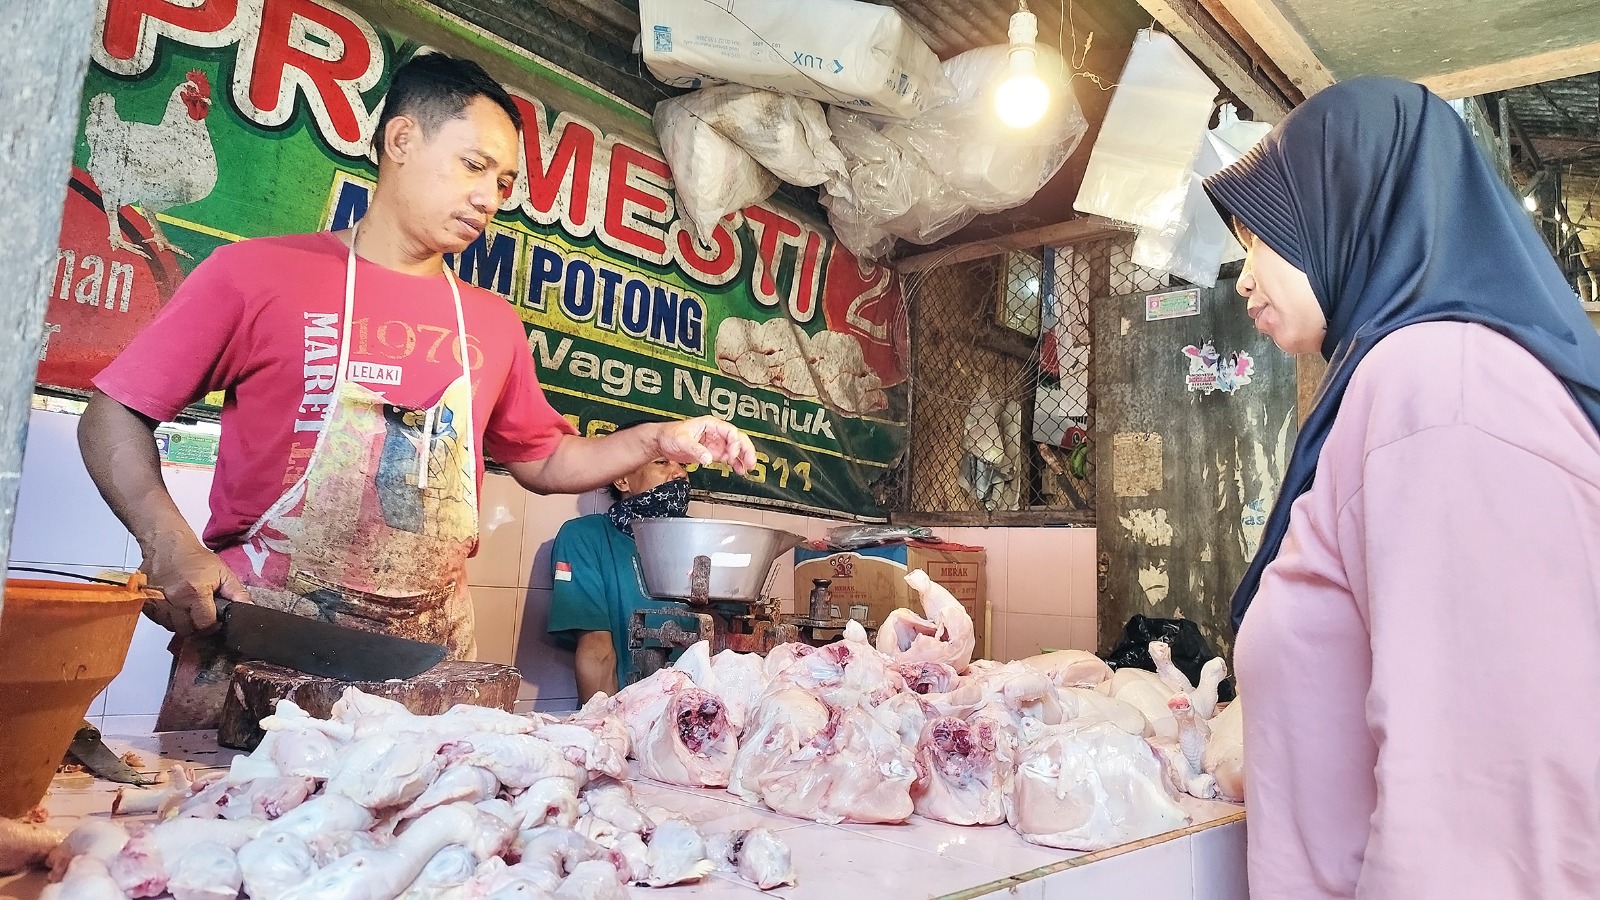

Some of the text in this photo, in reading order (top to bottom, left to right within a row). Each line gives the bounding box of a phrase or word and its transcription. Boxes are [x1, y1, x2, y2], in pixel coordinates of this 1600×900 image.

[793, 51, 823, 70] LUX
[525, 241, 707, 355] POTONG
[351, 317, 483, 371] 1976
[352, 364, 399, 382] LELAKI
[673, 367, 837, 440] Nganjuk
[941, 567, 968, 577] MERAK
